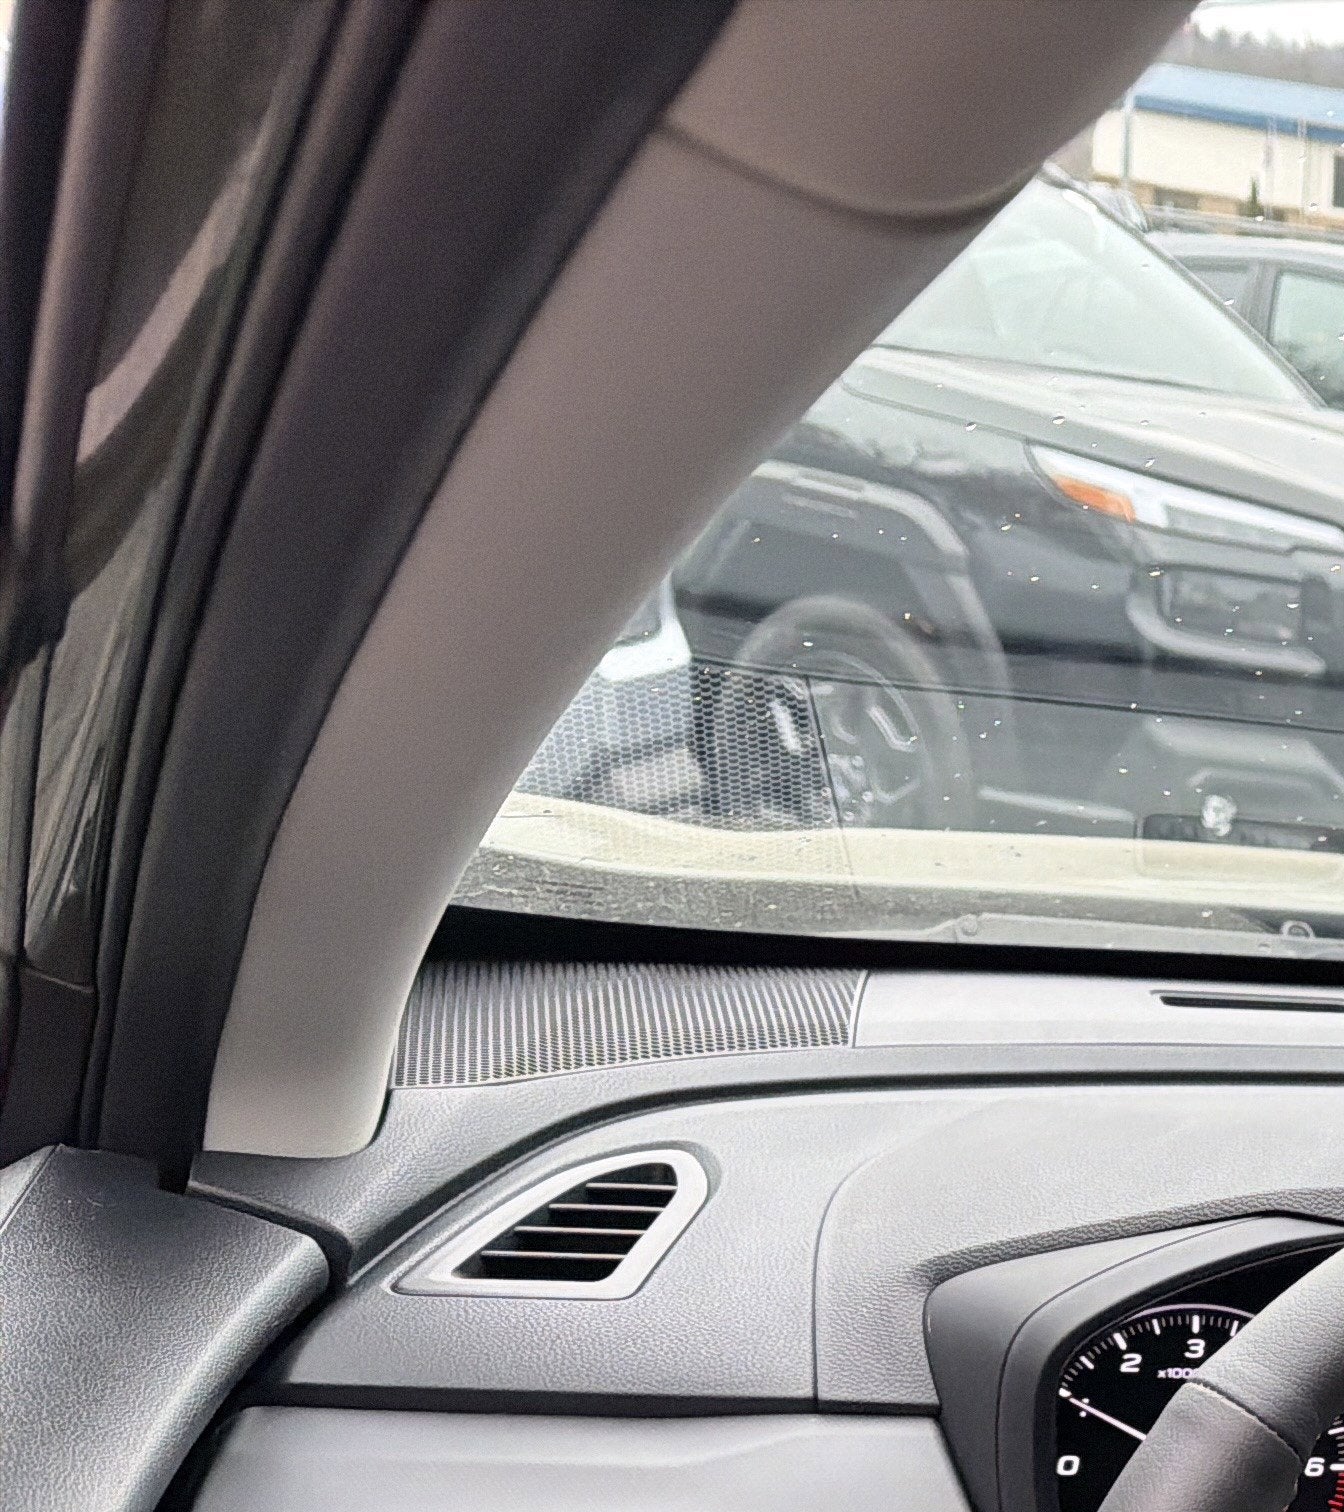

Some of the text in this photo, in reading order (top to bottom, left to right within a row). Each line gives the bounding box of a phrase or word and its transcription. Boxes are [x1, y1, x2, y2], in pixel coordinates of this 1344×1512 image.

[1184, 1338, 1205, 1359] 3
[1119, 1353, 1142, 1373] 2
[1056, 1454, 1080, 1476] 0
[1304, 1458, 1324, 1477] 6
